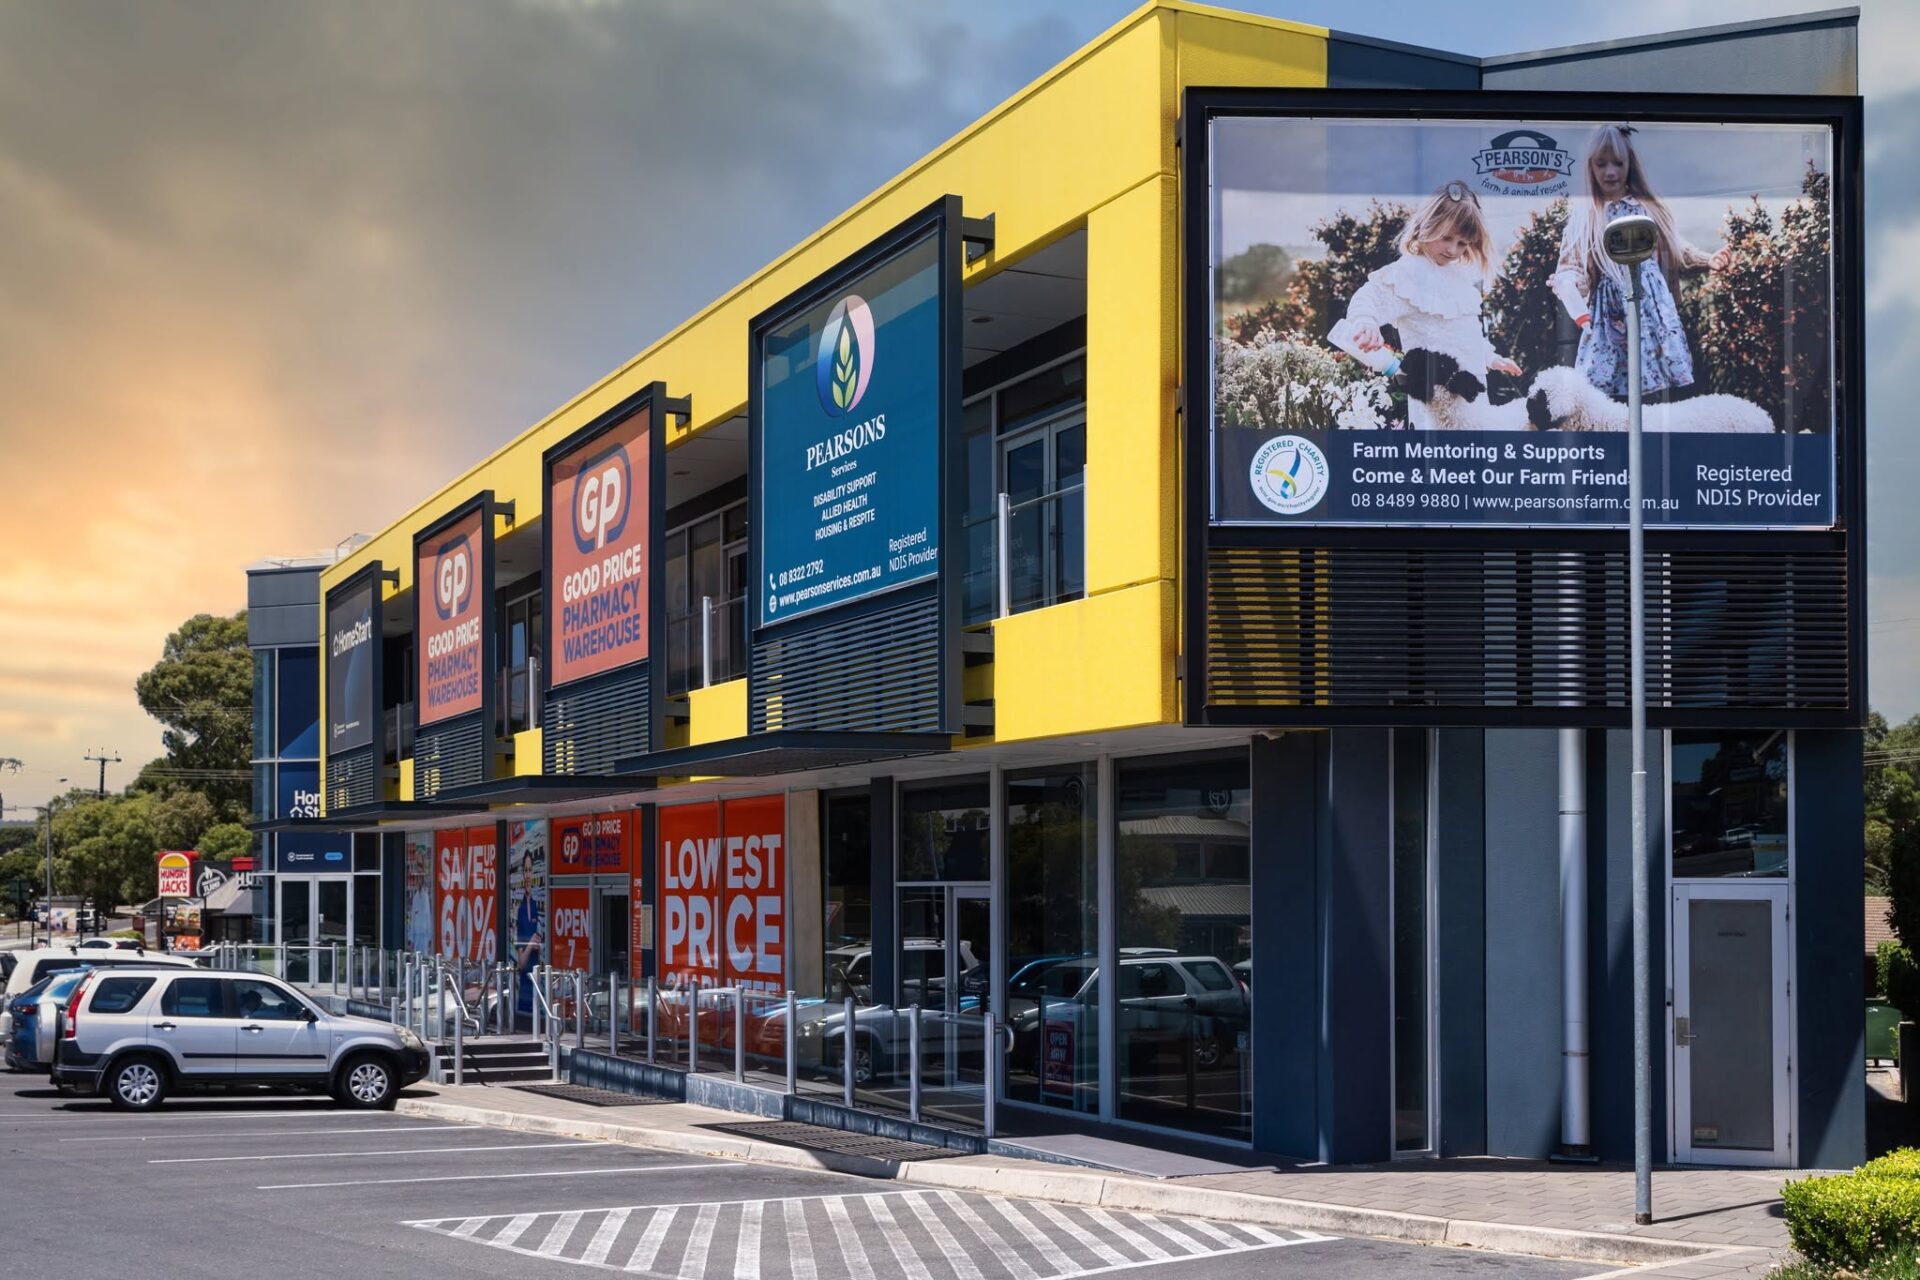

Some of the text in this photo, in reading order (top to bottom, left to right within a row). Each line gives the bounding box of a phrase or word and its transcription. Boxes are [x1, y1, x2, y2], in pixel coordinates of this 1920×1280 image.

[1485, 150, 1562, 168] PEARSON'S
[1481, 178, 1501, 193] farm
[1511, 184, 1539, 196] animal
[1541, 180, 1568, 195] rescue
[806, 413, 886, 471] PEARSONS
[1353, 442, 1605, 464] Farm Mentoring & Supports
[831, 460, 857, 478] Services
[1255, 440, 1324, 476] REGISTERED CHARITY
[813, 471, 877, 508] DISABILITY SUPPORT
[1352, 467, 1405, 484] Come
[1410, 468, 1424, 484] &
[1430, 468, 1476, 485] Meet
[1481, 468, 1515, 485] Our
[1520, 469, 1566, 485] Farm
[1697, 464, 1793, 486] Registered
[581, 466, 621, 550] GP
[821, 493, 868, 521] ALLIED HEALTH
[1351, 493, 1371, 508] 08
[1376, 493, 1416, 508] 8489
[1420, 494, 1460, 508] 9880
[1473, 494, 1680, 512] www.pearsonsfarm.cm.au
[1697, 489, 1821, 506] NDIS Provider
[815, 521, 842, 541] HOUSING
[849, 508, 876, 528] RESPITE
[889, 526, 927, 554] Registered
[563, 543, 641, 603] GOOD PRICE
[779, 559, 824, 587] 08 8322 2792
[889, 546, 938, 573] NDIS Provider
[440, 553, 467, 618] GP
[779, 564, 882, 607] www.pearsonservices.com.au
[562, 576, 641, 635] PHARMACY
[339, 616, 372, 654] HomeStart
[428, 616, 480, 659] GOOD PRICE
[563, 612, 641, 664] WAREHOUSE
[428, 643, 480, 686] PHARMACY
[428, 671, 480, 709] WAREHOUSE
[602, 819, 621, 835] PRICE
[484, 844, 496, 867] UP
[563, 835, 579, 864] GP
[665, 834, 782, 890] LOWEST
[161, 868, 188, 880] HUNGRY
[441, 845, 484, 891] SAVE
[484, 867, 496, 890] TO
[161, 880, 188, 893] JACK'S
[441, 895, 497, 963] 60%
[555, 907, 590, 938] OPEN
[665, 894, 782, 974] PRICE
[567, 939, 576, 967] 7
